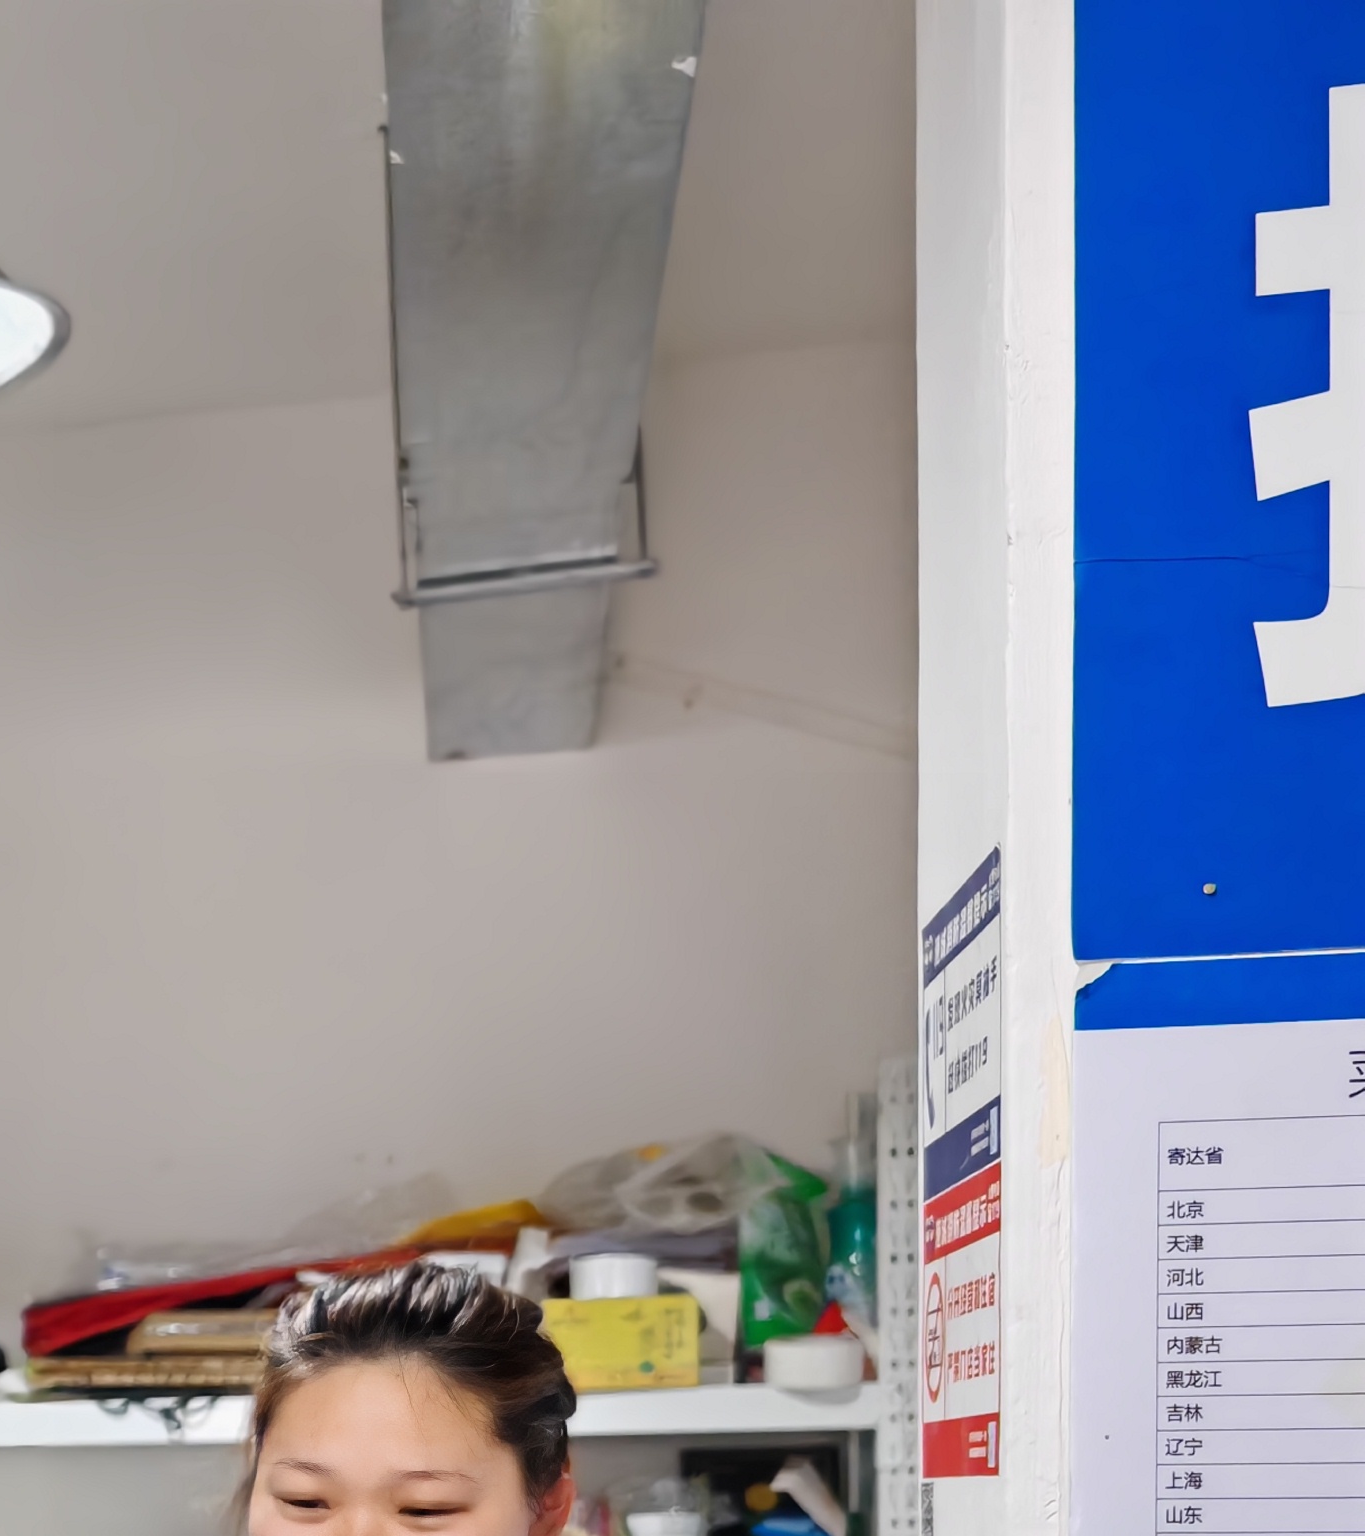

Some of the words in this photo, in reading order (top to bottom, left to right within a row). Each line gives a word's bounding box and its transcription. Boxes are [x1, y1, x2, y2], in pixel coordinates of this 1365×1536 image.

[1167, 1147, 1223, 1165] 寄达省
[1166, 1200, 1204, 1218] 北京
[1166, 1234, 1204, 1252] 天津
[1166, 1268, 1203, 1286] 河北
[1166, 1302, 1203, 1320] 山西
[1166, 1336, 1222, 1353] 内蒙古
[1166, 1370, 1221, 1388] 黑龙江
[1166, 1403, 1202, 1422] 吉林
[1165, 1438, 1202, 1455] 辽宁
[1165, 1471, 1202, 1489] 上海
[1165, 1506, 1202, 1524] 山东
